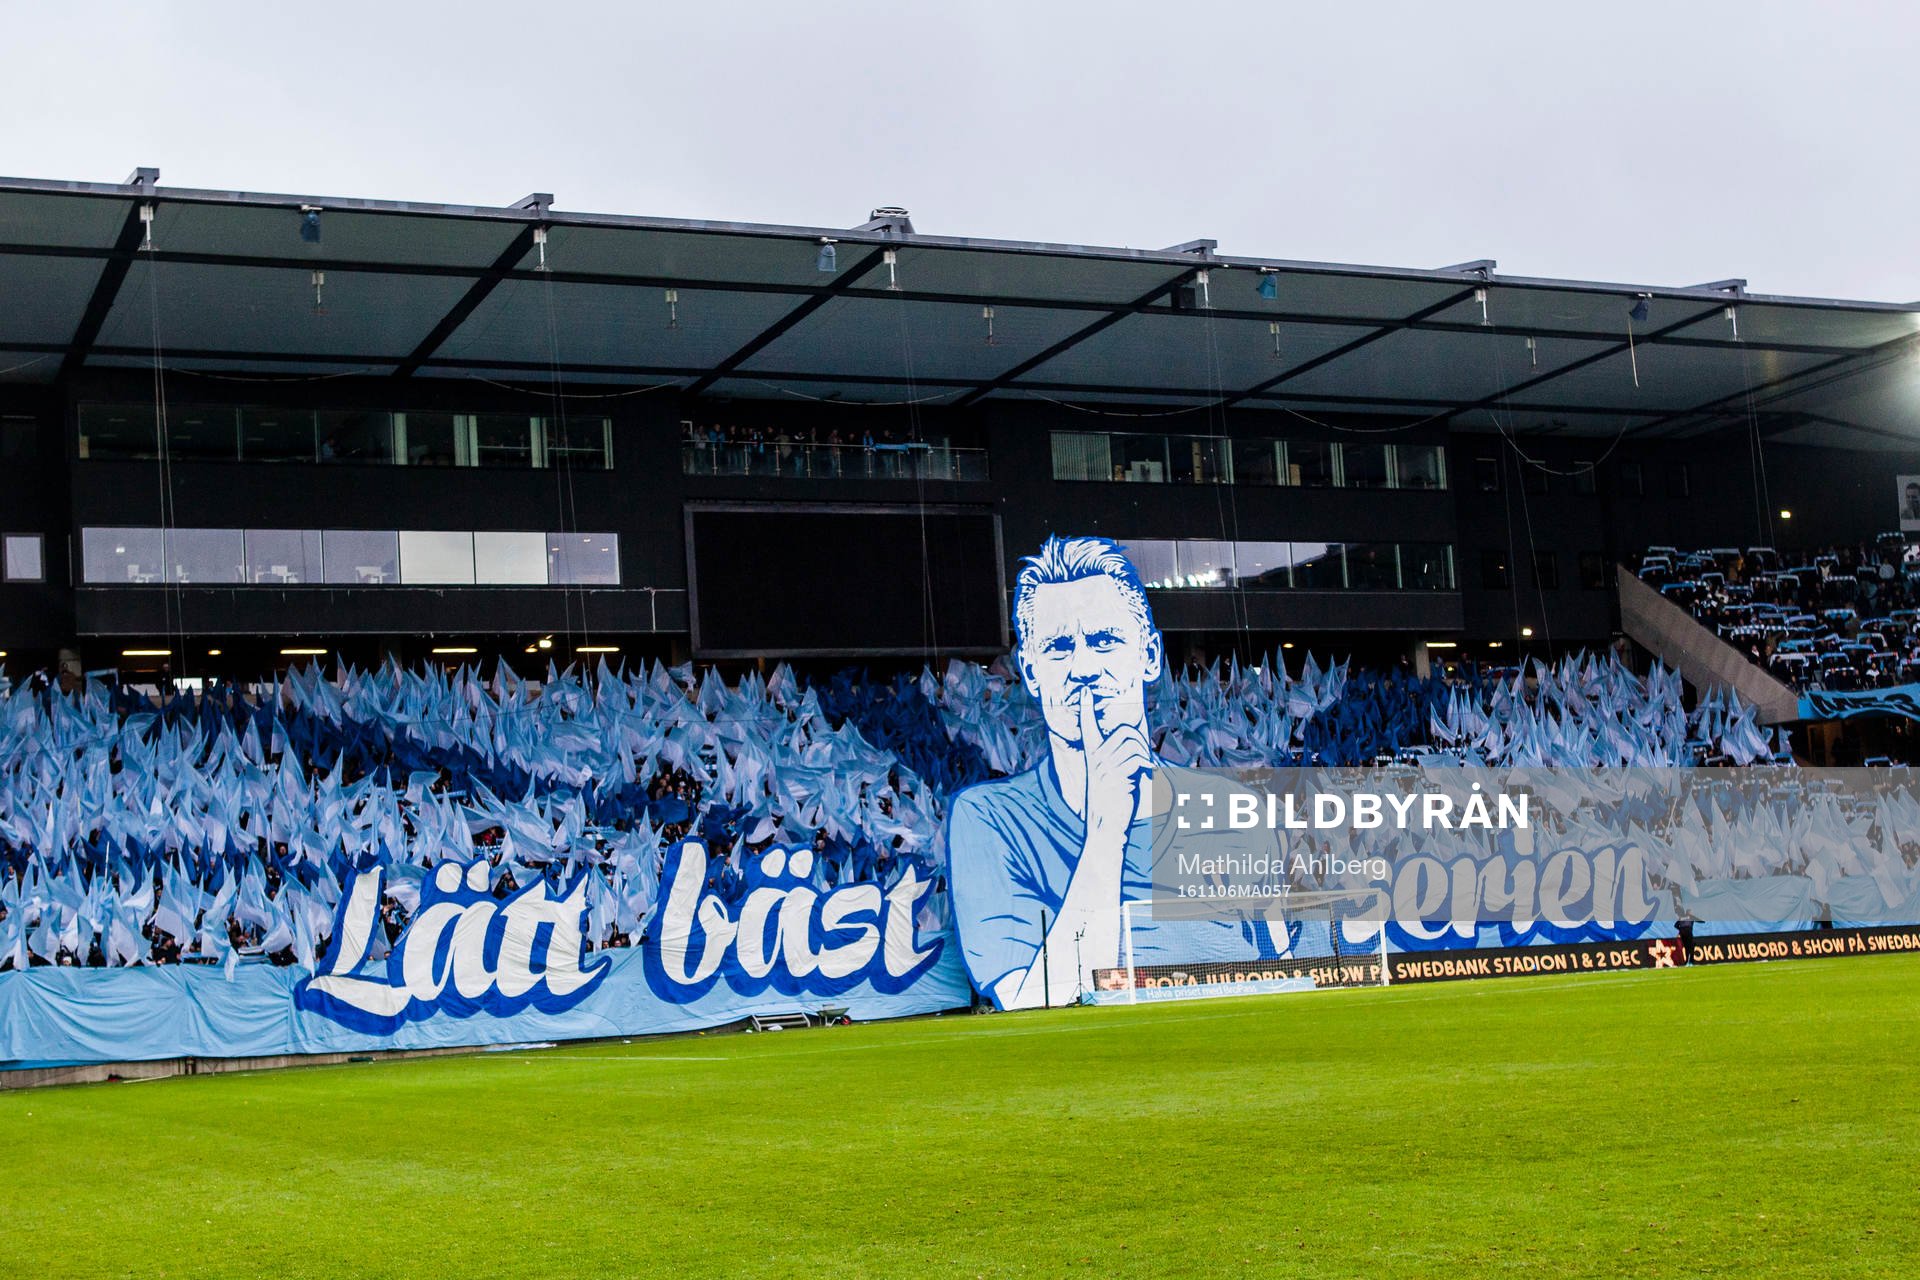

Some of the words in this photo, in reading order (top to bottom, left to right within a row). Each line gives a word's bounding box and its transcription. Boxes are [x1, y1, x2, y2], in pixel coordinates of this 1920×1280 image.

[303, 858, 610, 1018] Lätt
[659, 841, 937, 986] bäst
[1342, 825, 1656, 946] serien
[1727, 943, 1789, 960] JULBORD
[1792, 940, 1802, 955] &
[1803, 937, 1845, 955] SHOW
[1849, 932, 1866, 952] PÅ
[1868, 933, 1920, 952] SWEDBA
[1309, 965, 1364, 985] SHOW
[1396, 958, 1490, 979] SWEDBANK
[1495, 953, 1567, 974] STADION
[1570, 954, 1579, 970] 1
[1582, 952, 1593, 968] &
[1598, 951, 1607, 967] 2
[1610, 949, 1641, 966] DEC
